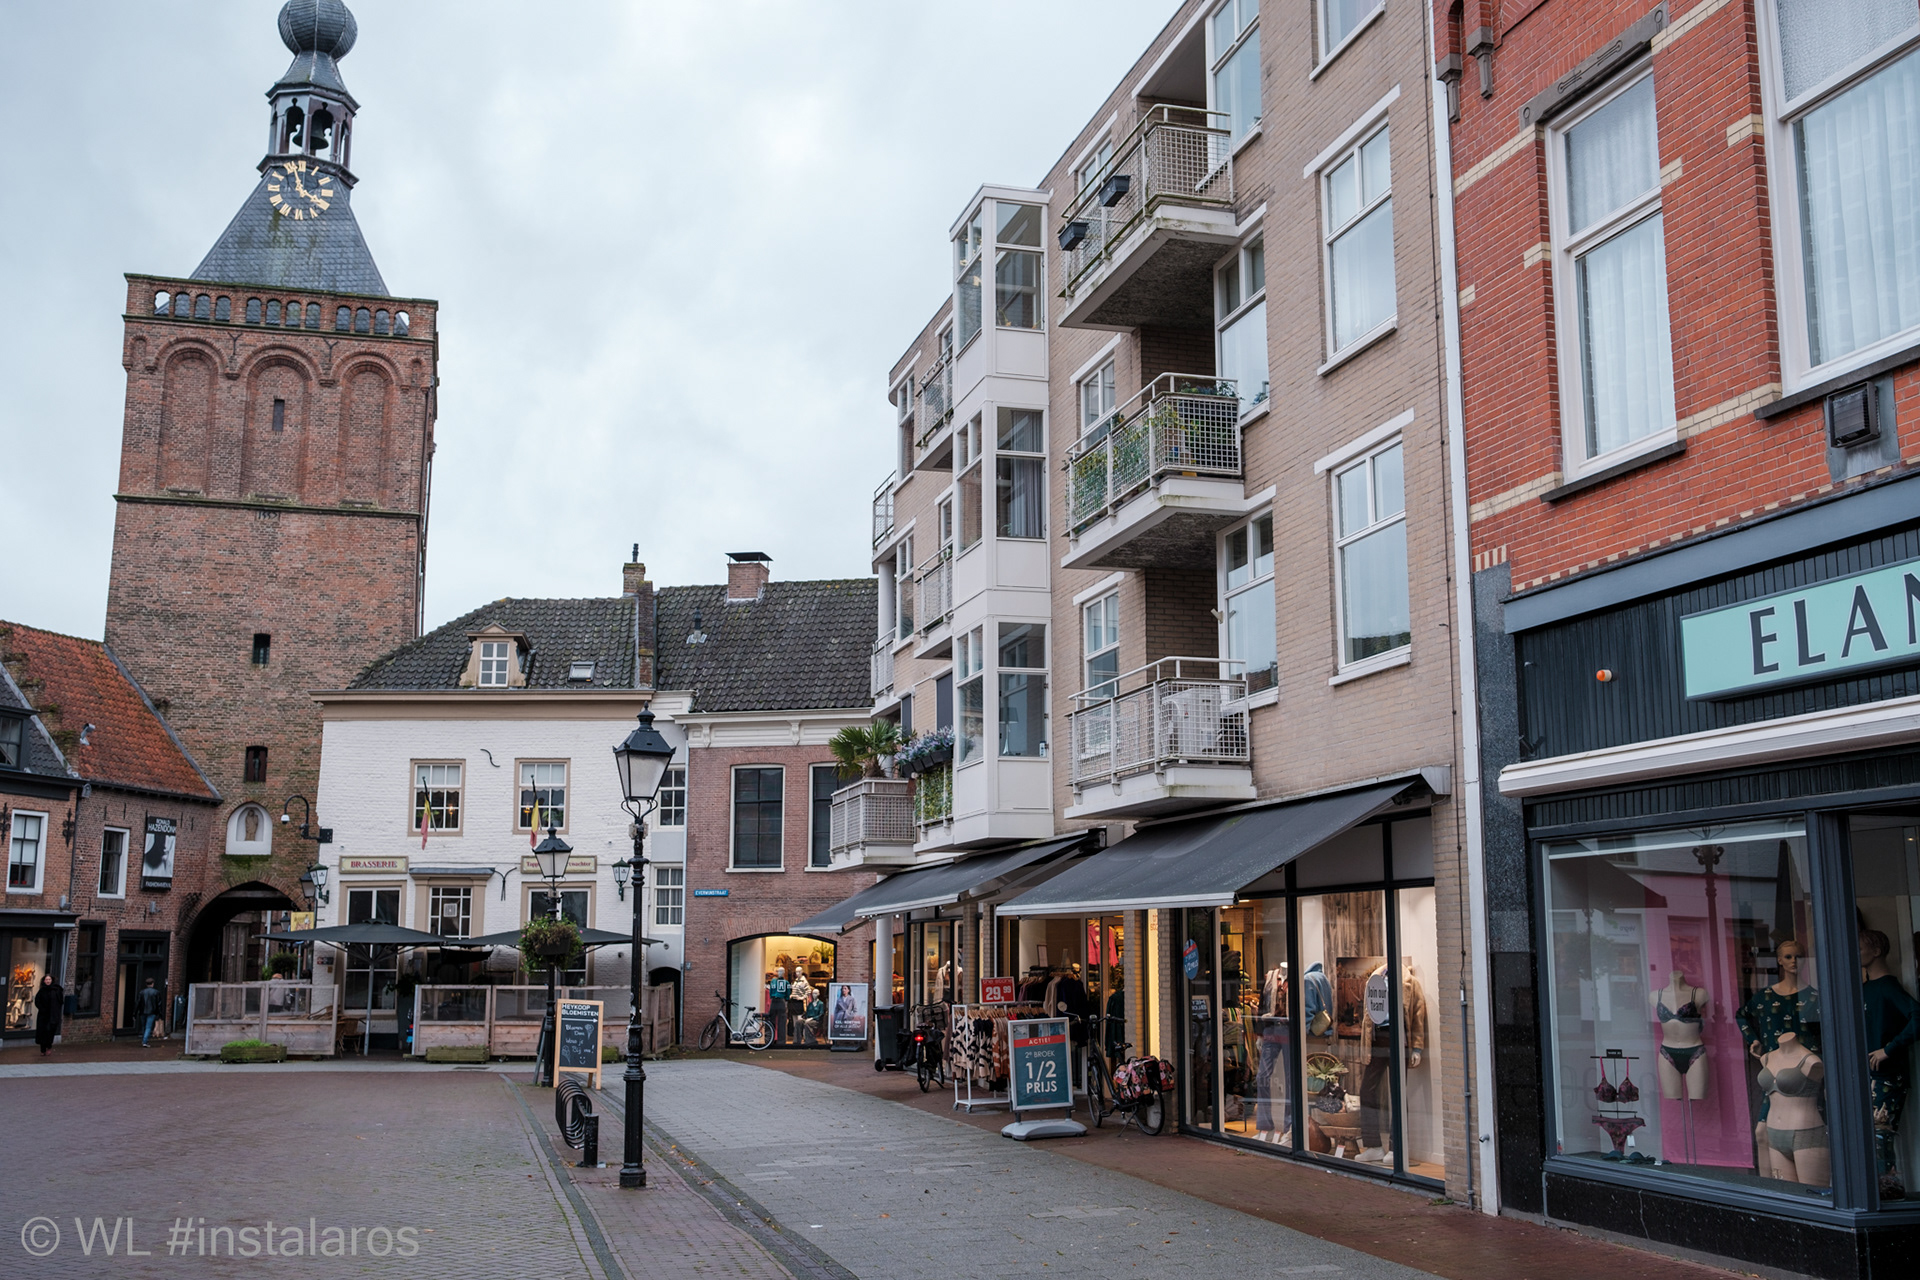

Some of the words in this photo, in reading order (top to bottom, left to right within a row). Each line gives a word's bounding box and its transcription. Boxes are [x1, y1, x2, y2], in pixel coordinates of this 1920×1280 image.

[350, 860, 398, 869] BRASSERIE
[1367, 986, 1378, 998] Join
[1378, 988, 1387, 999] our
[1370, 999, 1385, 1011] team!
[561, 1009, 599, 1017] BLOEMISTEN
[1028, 1037, 1051, 1045] ACTIE!
[1033, 1050, 1055, 1058] BROEK
[1026, 1060, 1057, 1081] 1/2
[1026, 1081, 1058, 1094] PRIJS
